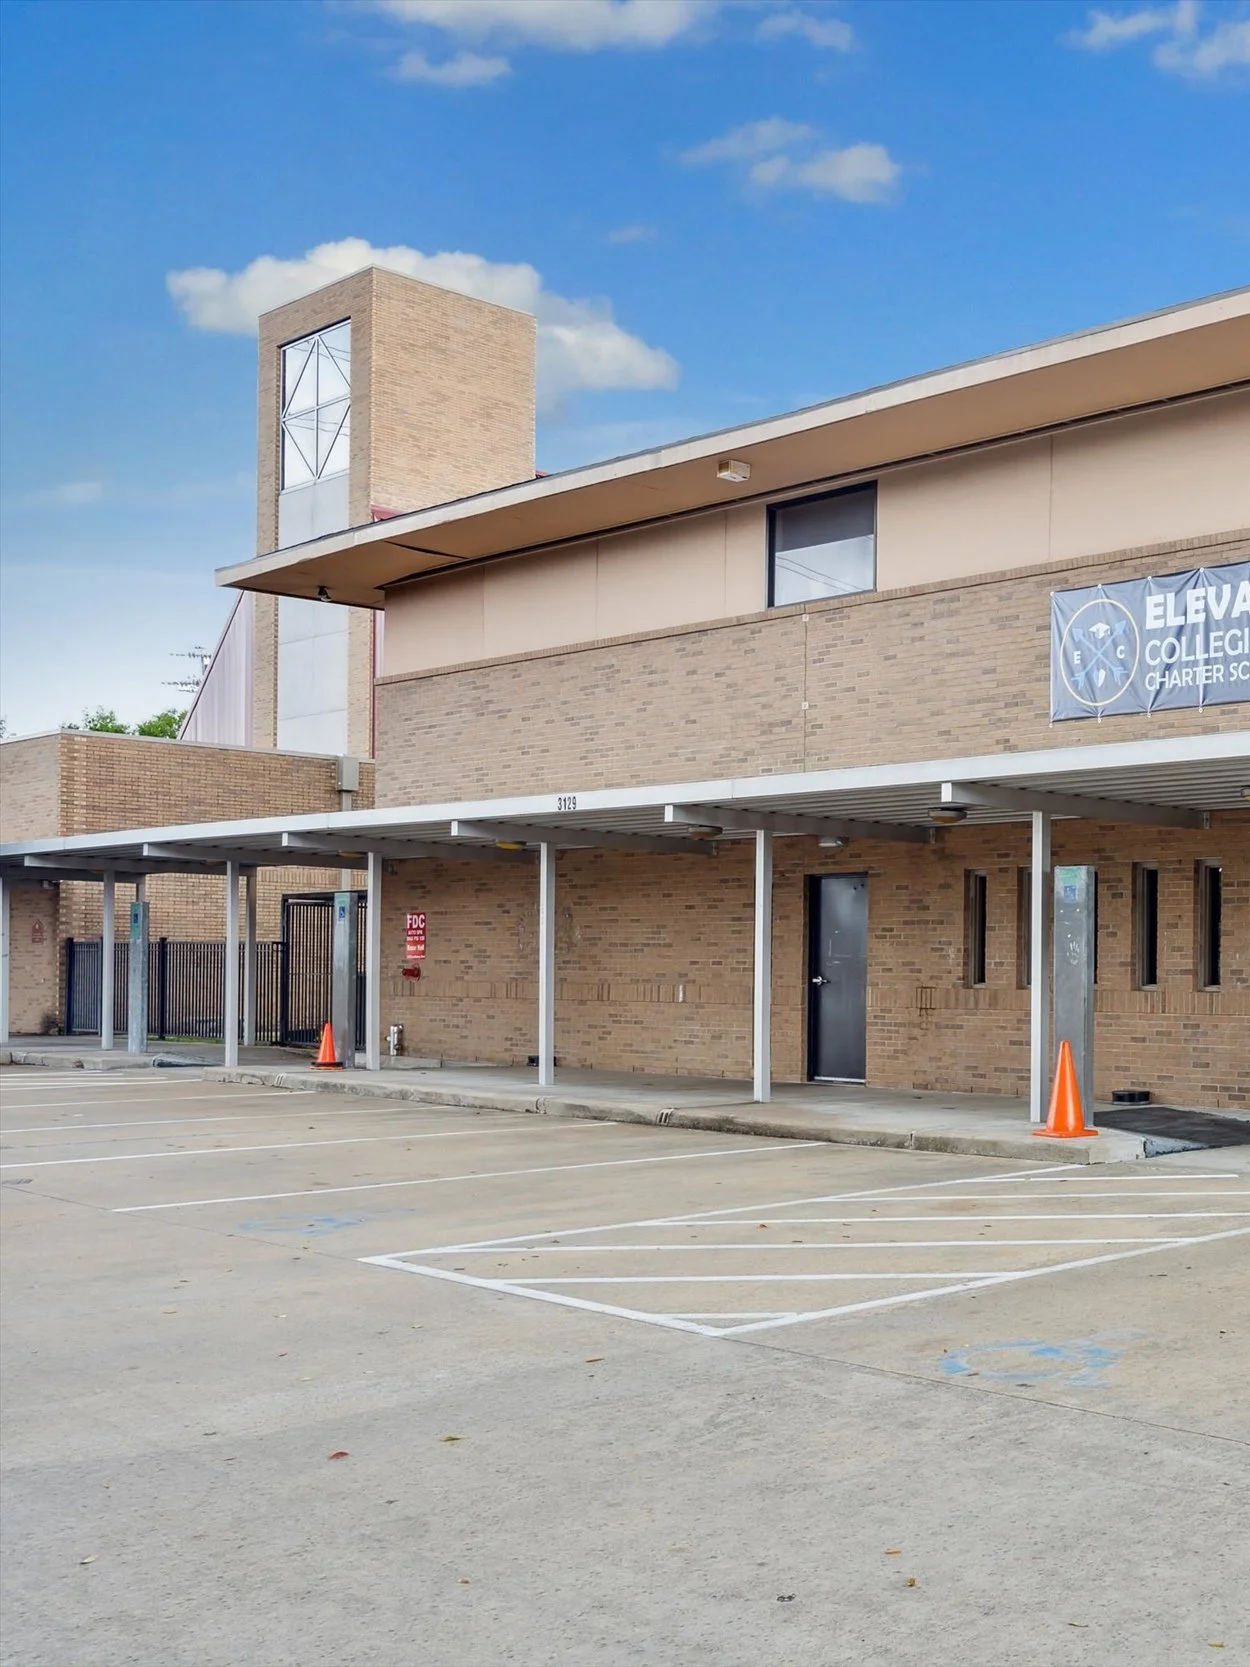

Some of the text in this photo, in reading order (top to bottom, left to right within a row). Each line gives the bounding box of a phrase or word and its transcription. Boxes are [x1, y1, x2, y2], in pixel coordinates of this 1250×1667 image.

[1145, 664, 1224, 691] CHARTER
[557, 796, 577, 810] 3129
[407, 914, 425, 928] FDC
